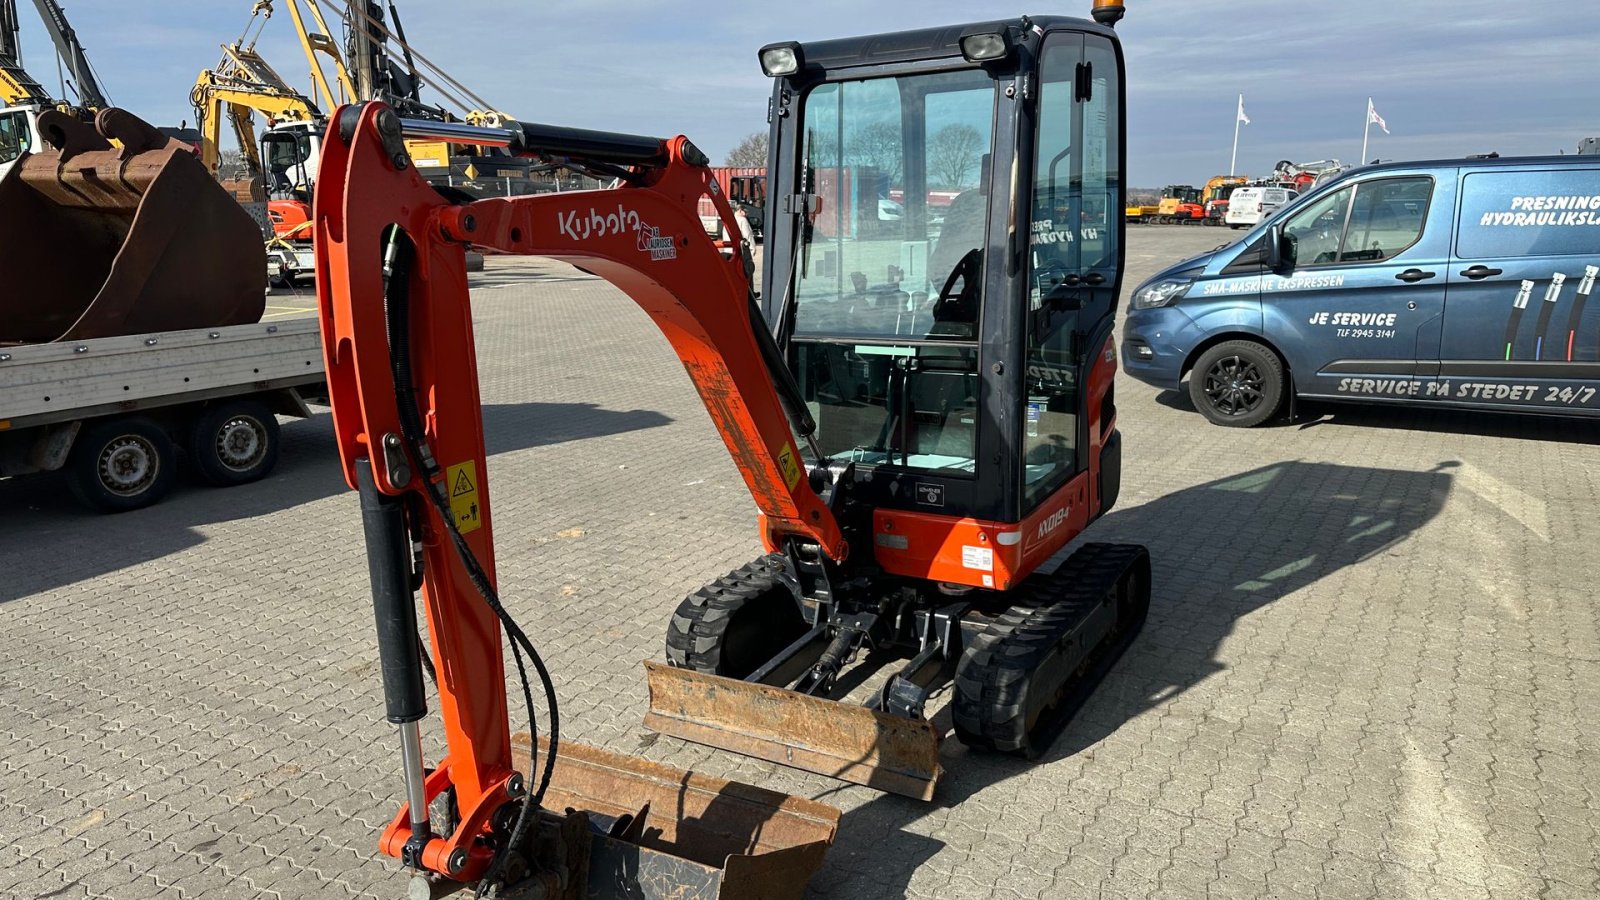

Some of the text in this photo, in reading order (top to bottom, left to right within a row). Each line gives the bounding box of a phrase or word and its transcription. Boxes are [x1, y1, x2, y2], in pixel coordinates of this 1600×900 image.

[1511, 196, 1600, 211] PRESNING
[558, 204, 640, 241] Kubota
[1203, 275, 1344, 294] SMÅ-MASKINE EKSPRESSEN
[1309, 312, 1397, 326] JE SERVICE
[1337, 329, 1395, 338] TLF 2945 3141
[1338, 378, 1595, 404] SERVICE PÅ STEDET 24/7
